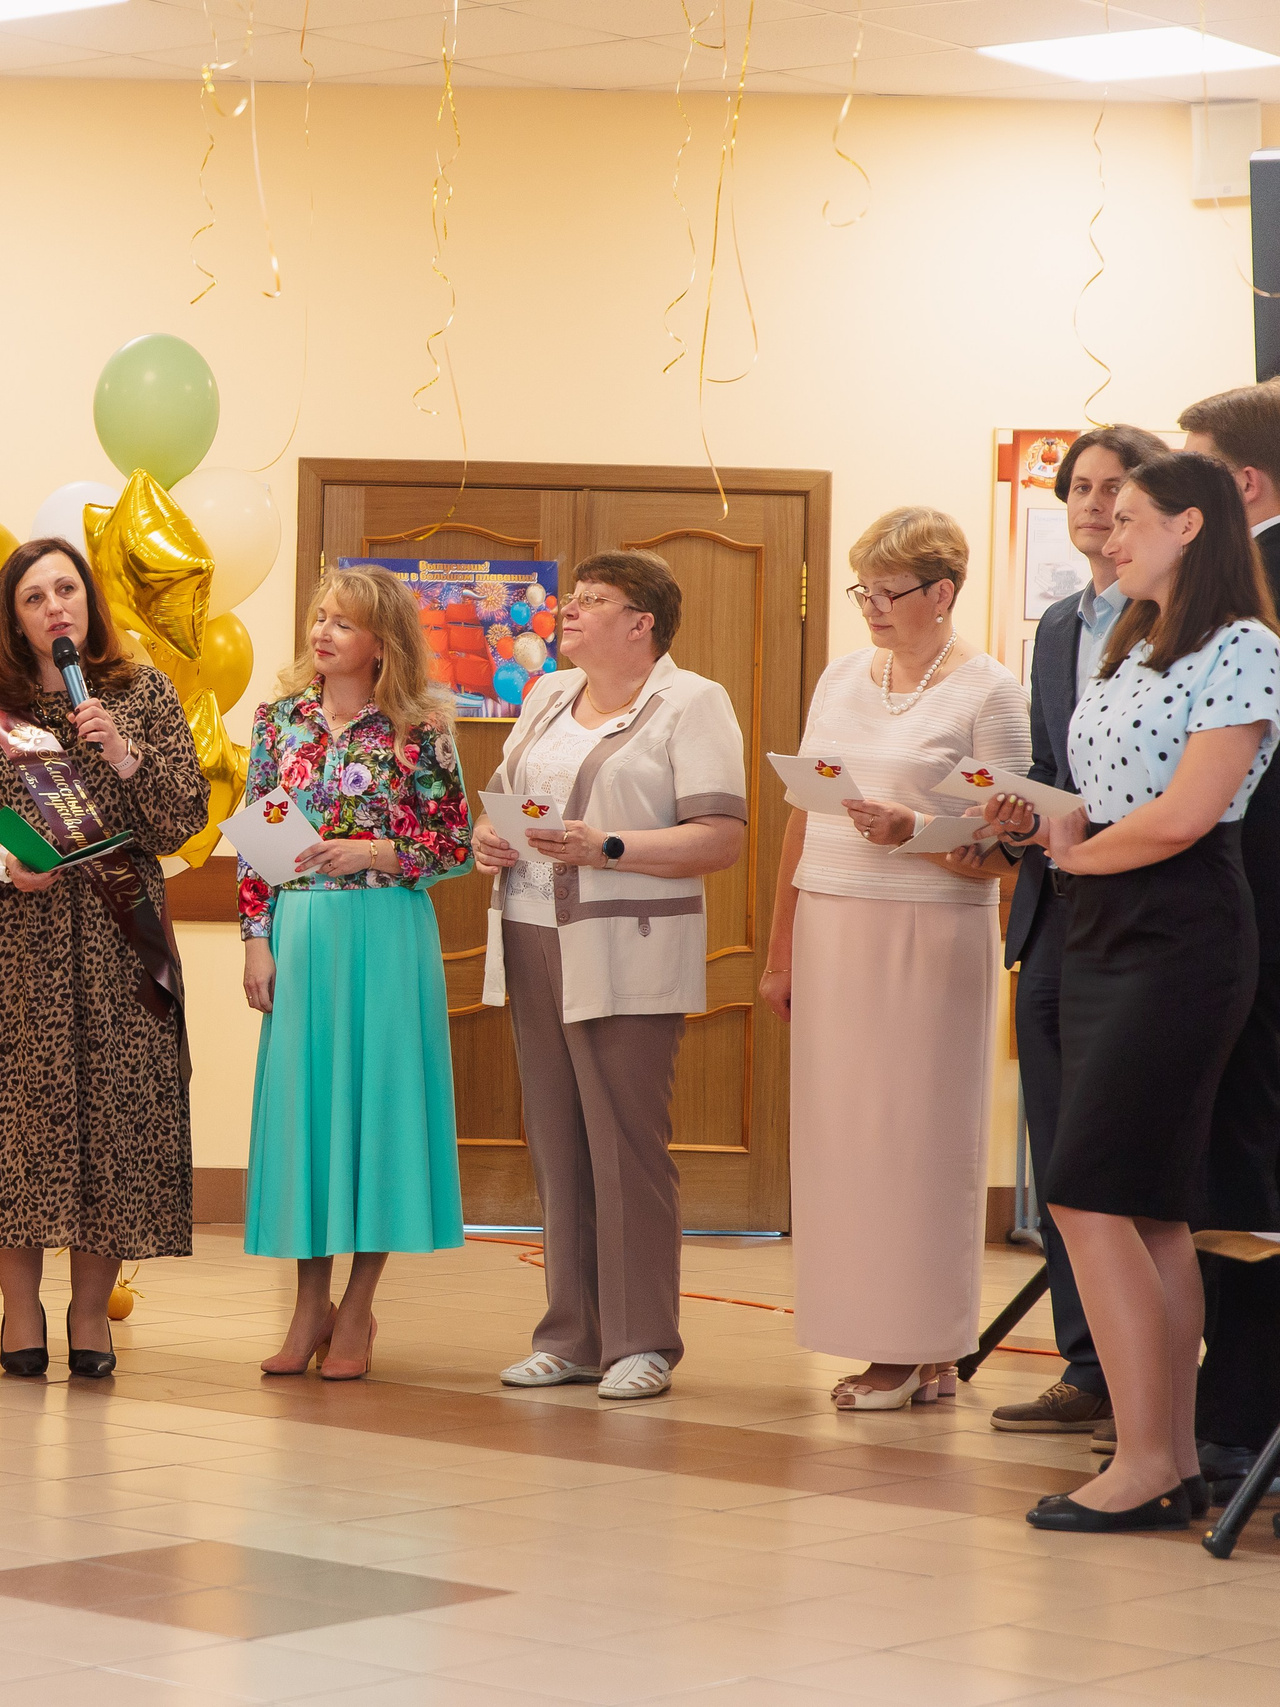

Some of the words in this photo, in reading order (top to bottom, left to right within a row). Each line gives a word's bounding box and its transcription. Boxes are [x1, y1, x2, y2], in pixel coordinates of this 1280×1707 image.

[418, 560, 490, 575] Выпускник!
[36, 746, 91, 817] Классный
[100, 862, 146, 913] 2024
